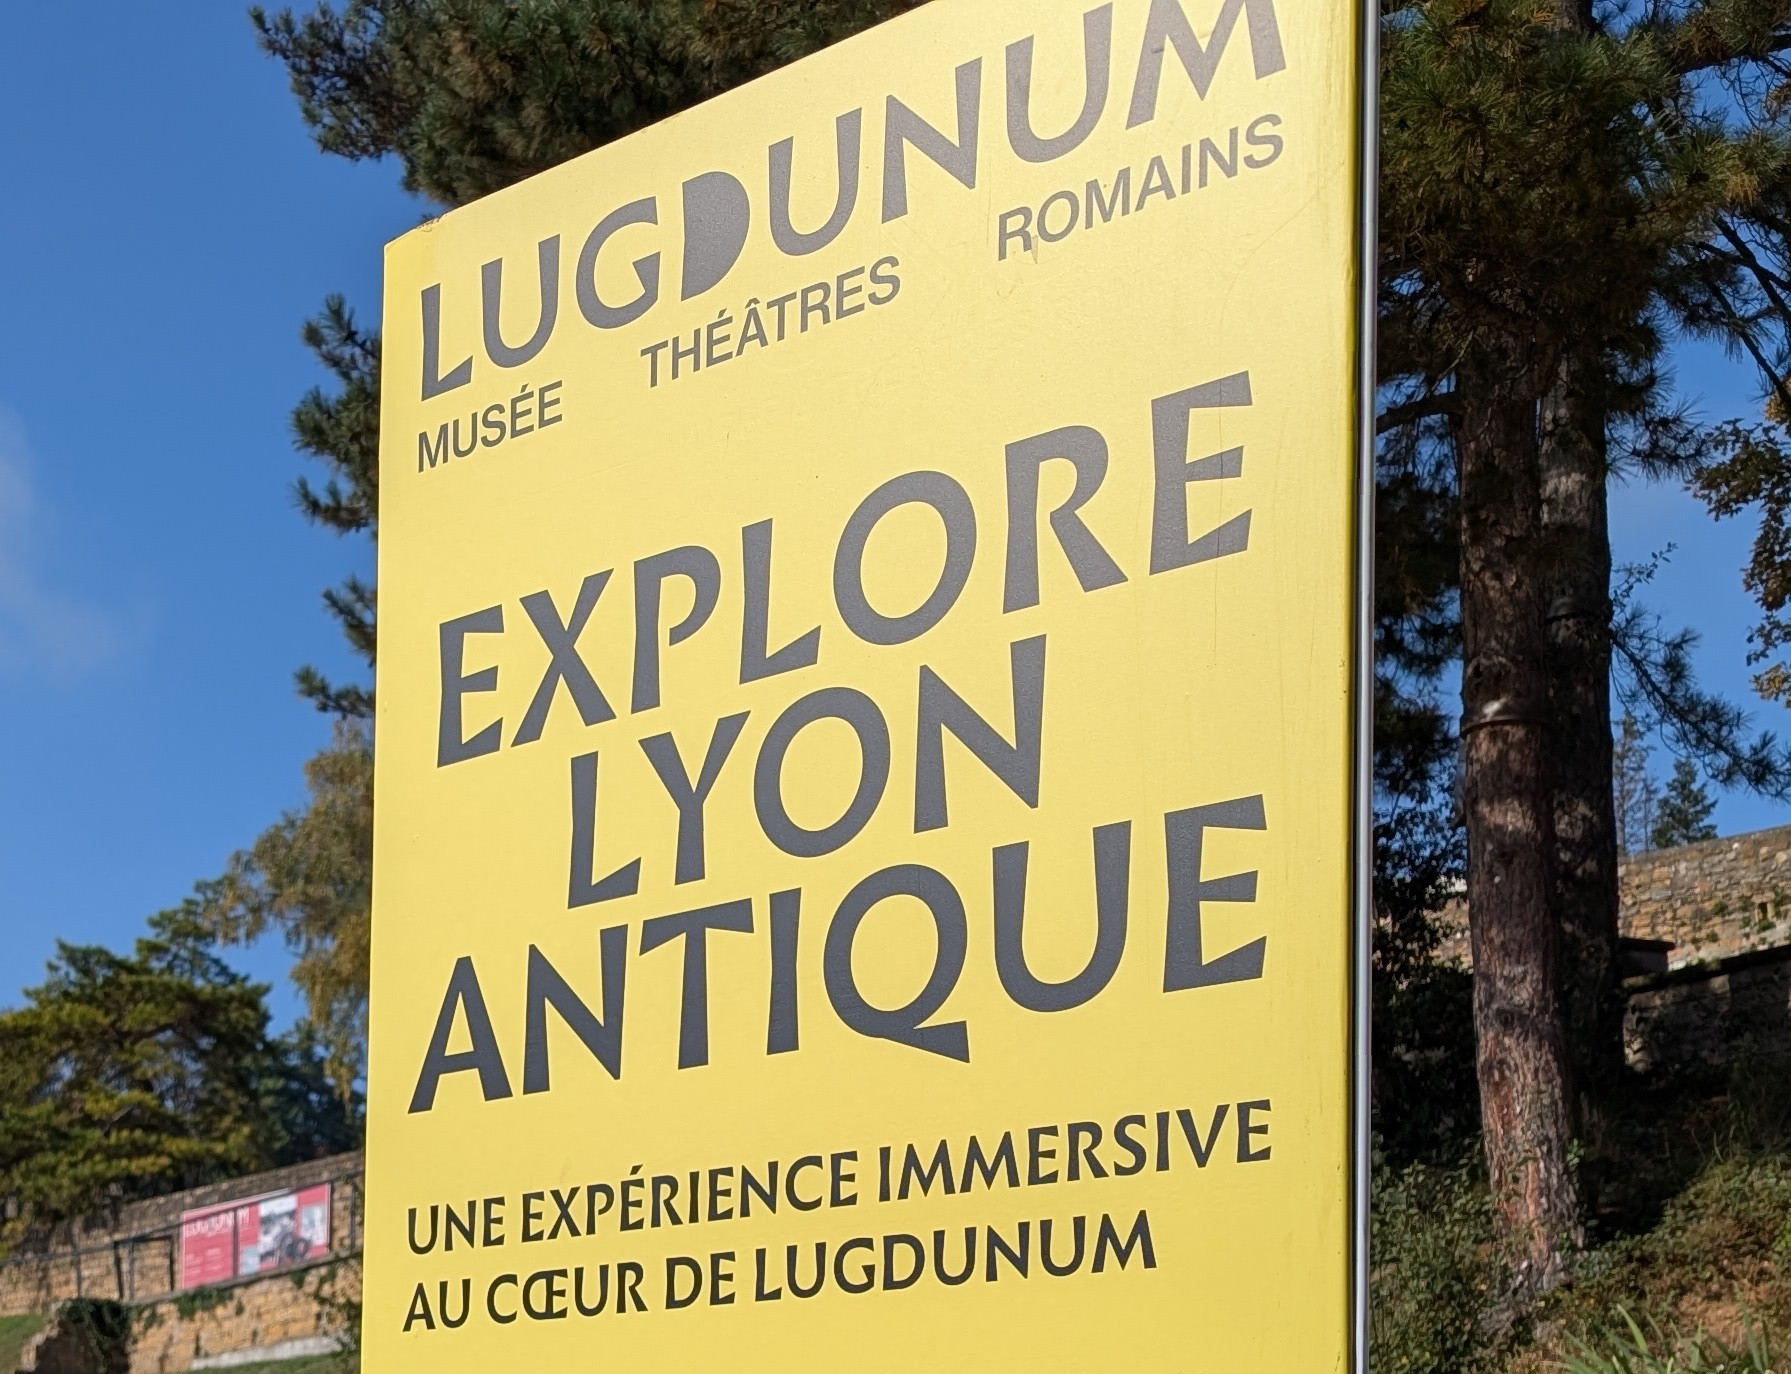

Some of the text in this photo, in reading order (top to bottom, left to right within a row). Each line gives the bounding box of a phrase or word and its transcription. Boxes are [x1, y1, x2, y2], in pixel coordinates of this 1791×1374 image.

[417, 113, 1285, 473] MUSÉE THÉÂTRES ROMAINS
[420, 0, 1287, 402] LUGDUNUM
[437, 370, 1253, 769] EXPLORE
[567, 633, 1047, 910] LYON
[407, 793, 1268, 1115] ANTIQUE
[402, 1209, 1158, 1333] AU CŒUR DE LUGDUNUM
[407, 1098, 1272, 1255] UNE EXPÉRIENCE IMMERSIVE
